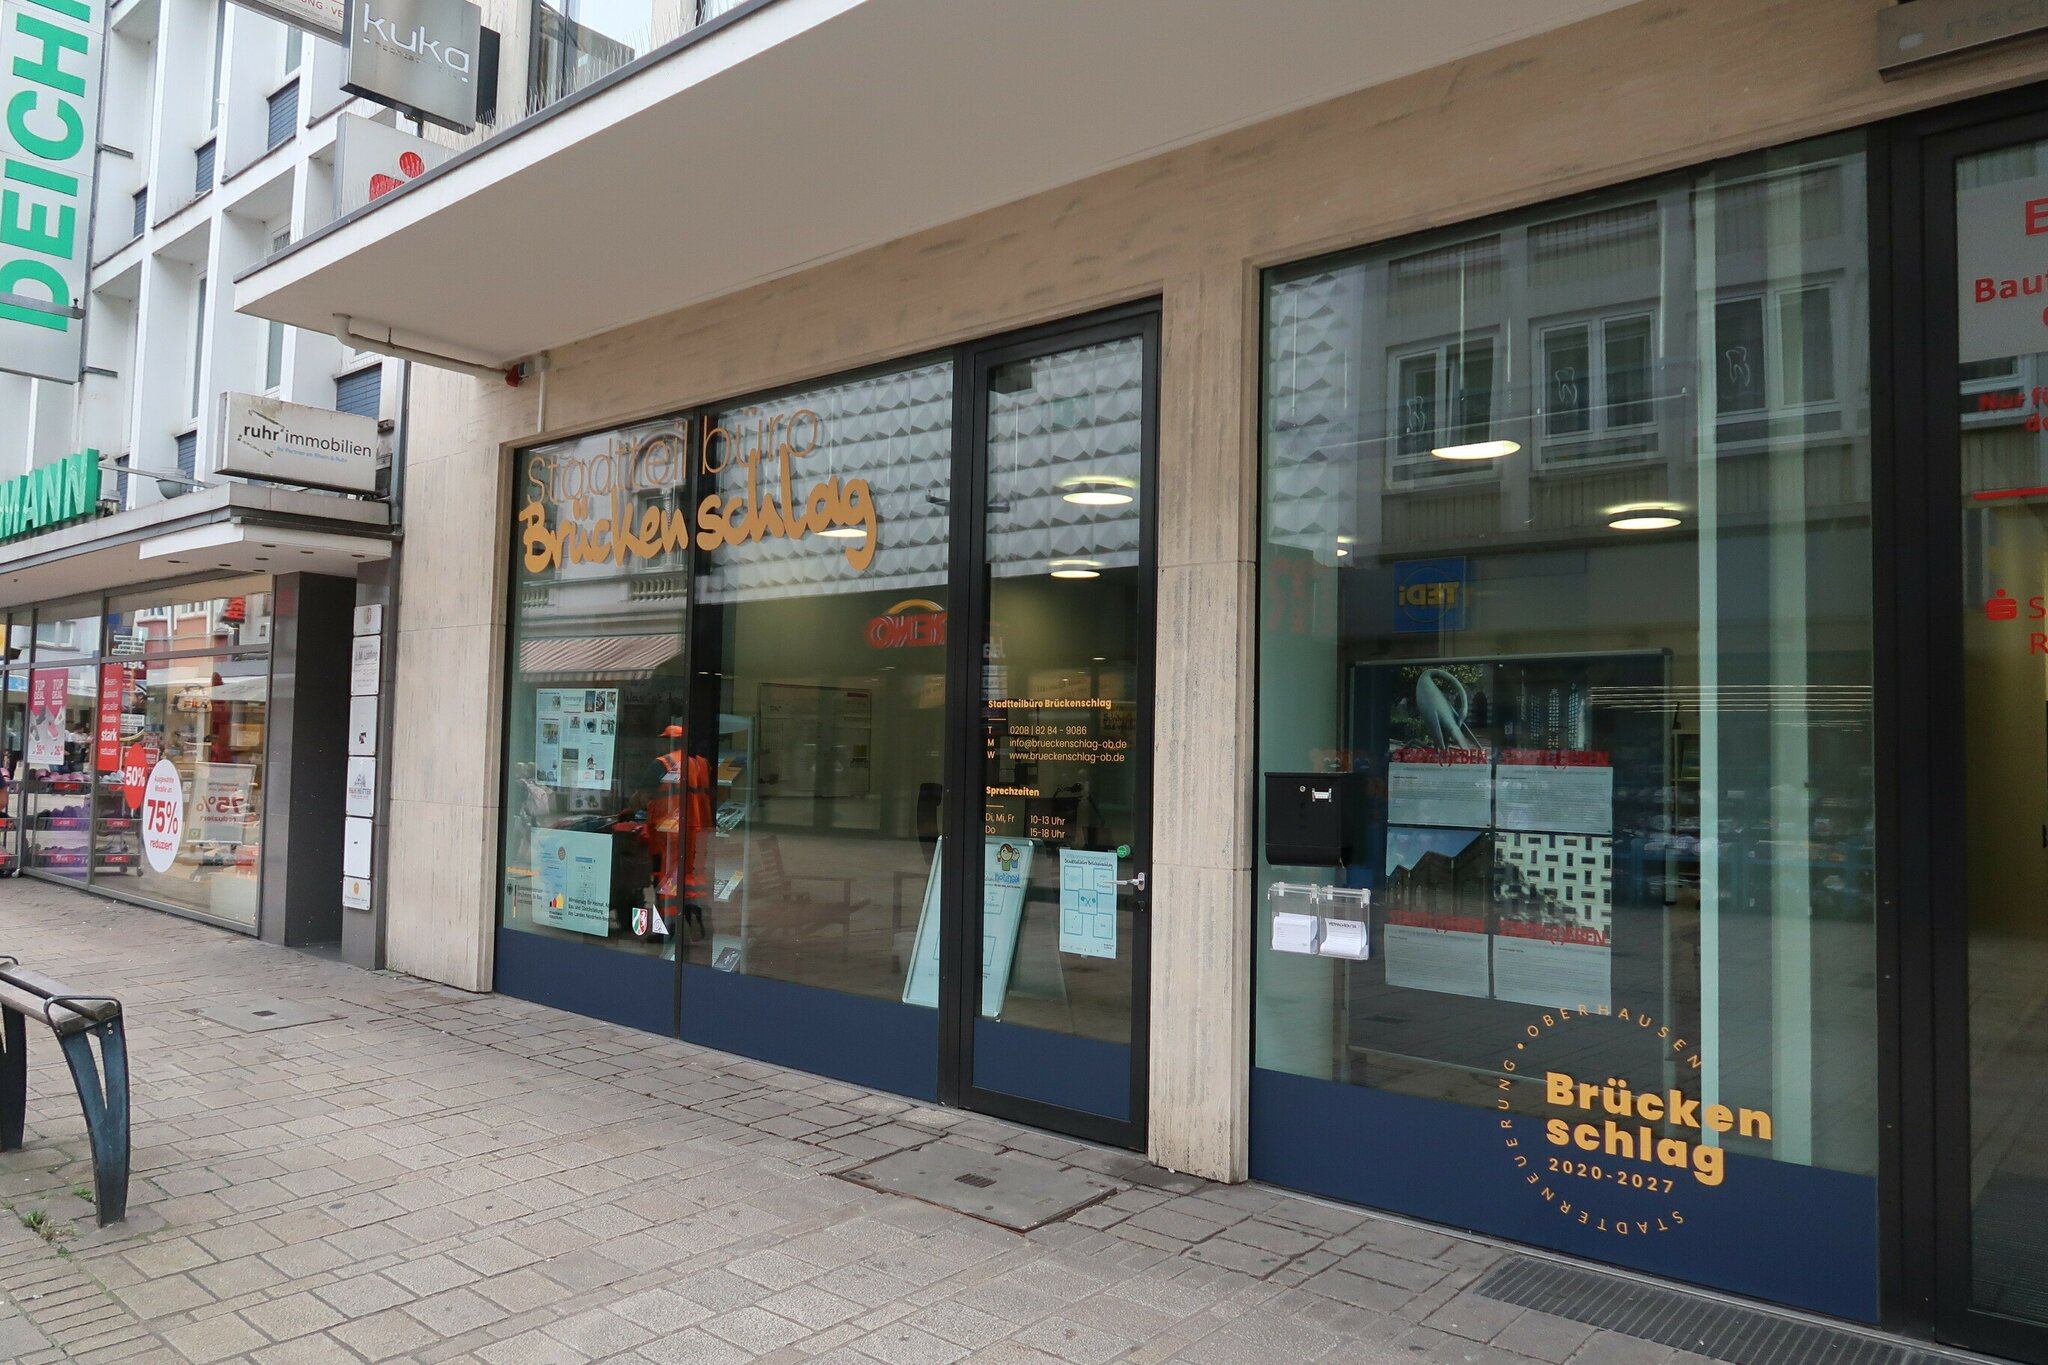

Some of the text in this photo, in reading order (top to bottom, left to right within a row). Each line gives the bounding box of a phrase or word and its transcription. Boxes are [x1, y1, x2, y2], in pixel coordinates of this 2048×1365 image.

[363, 3, 470, 74] kuka
[1974, 270, 2048, 303] Bau
[0, 449, 99, 538] MANN
[34, 679, 63, 691] TOP TOP
[988, 699, 1112, 710] Stadtteilbüro Brückenschlag
[101, 728, 117, 742] stark
[988, 727, 992, 735] T
[1009, 726, 1030, 735] 0208
[1035, 726, 1045, 735] 82
[1047, 726, 1058, 735] 84
[1065, 726, 1087, 736] 9086
[987, 739, 1128, 750] M info@brueckenschlag-ob.de
[987, 751, 1125, 764] W www.brueckenschlag-ob.de
[125, 766, 146, 787] 50%
[986, 786, 1040, 797] Sprechzeiten
[147, 799, 179, 835] 75%
[985, 813, 1066, 826] Di, Mi, Fr 10-13 Uhr
[985, 825, 1066, 839] Do 15-18 Uhr
[149, 839, 173, 851] reduziert
[1527, 1004, 1702, 1069] OBERHAUSEN
[1546, 1071, 1772, 1140] Brücken
[1497, 1059, 1684, 1235] STADTERNEUERUNG
[1546, 1118, 1725, 1186] schlag
[1548, 1158, 1675, 1194] 2020-2027
